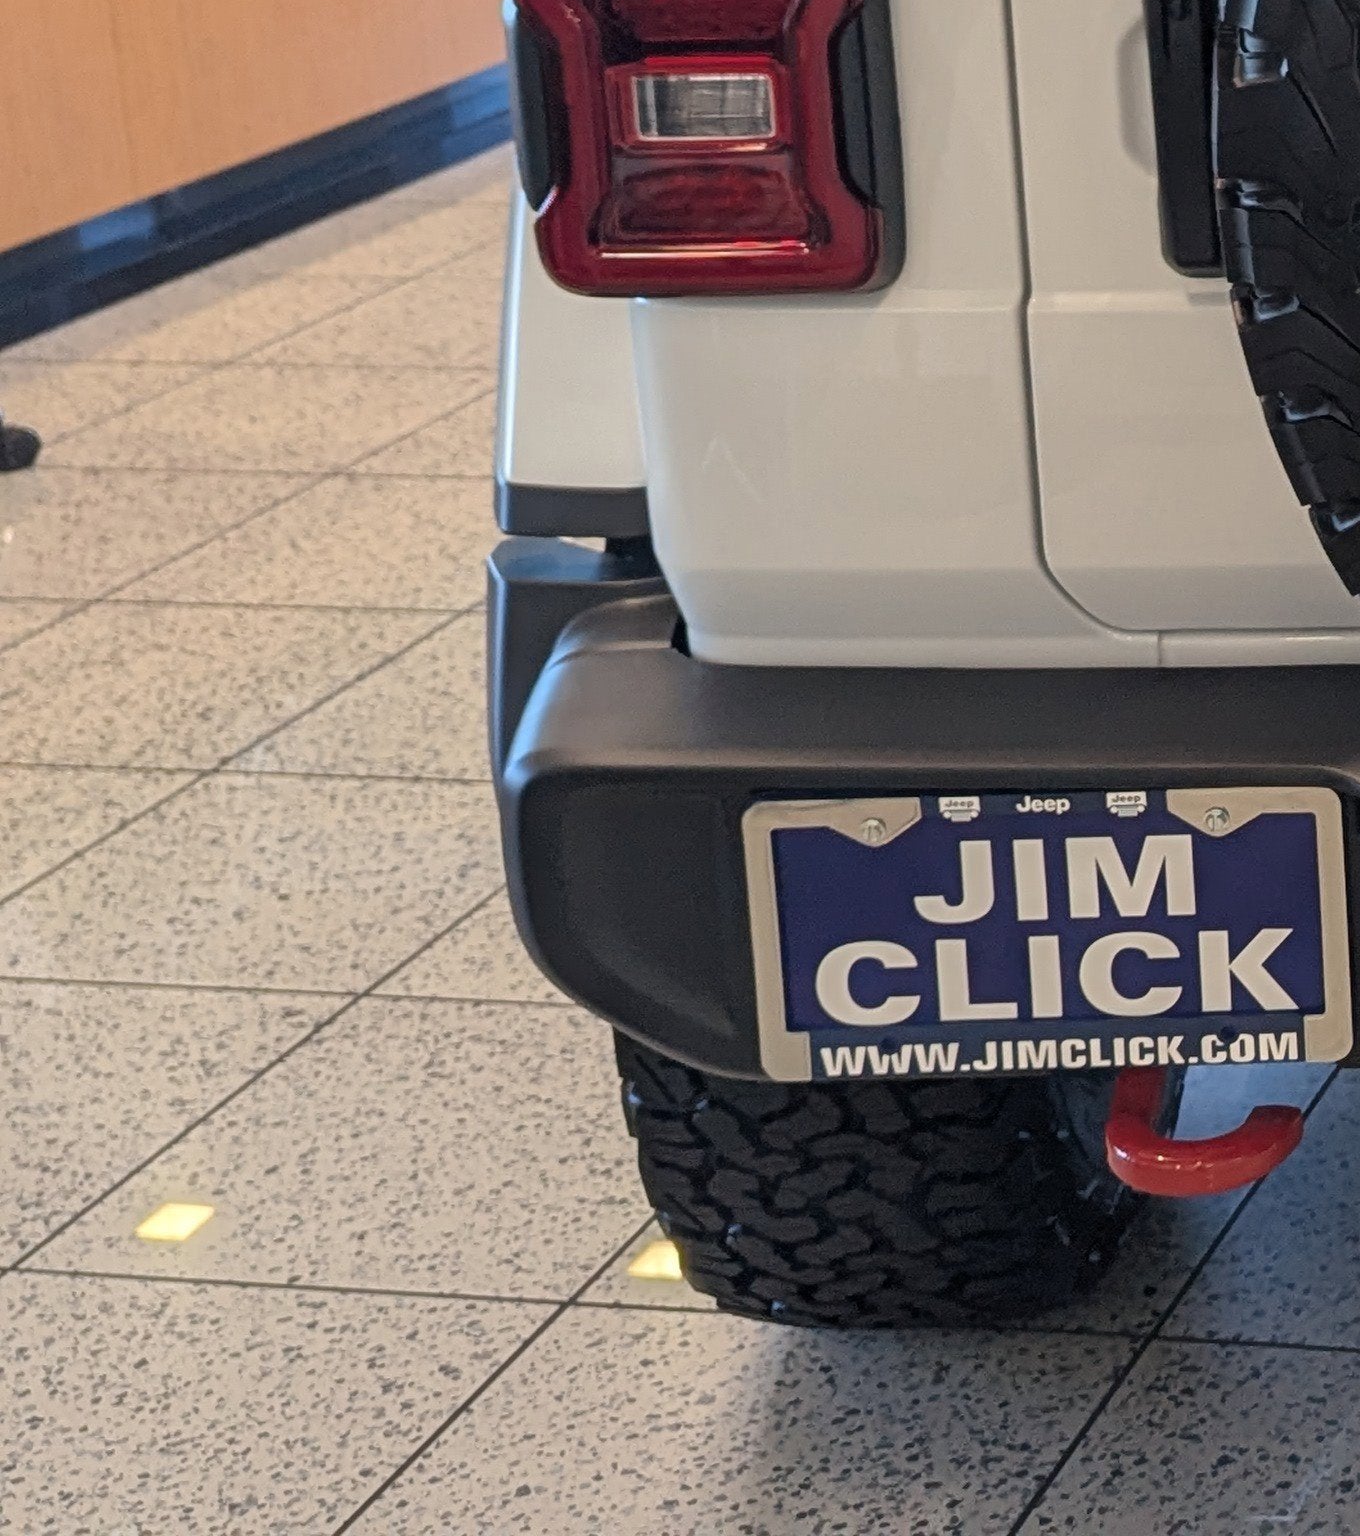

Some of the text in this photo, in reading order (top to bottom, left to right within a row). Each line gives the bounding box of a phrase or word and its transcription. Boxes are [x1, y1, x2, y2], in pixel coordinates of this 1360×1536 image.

[945, 798, 974, 808] Jeep
[1015, 795, 1071, 815] Jeep
[1112, 793, 1141, 804] Jeep
[914, 833, 1197, 924] JIM
[815, 927, 1300, 1027] CLICK
[820, 1031, 1300, 1077] WWW.JIMCLICK.COM
